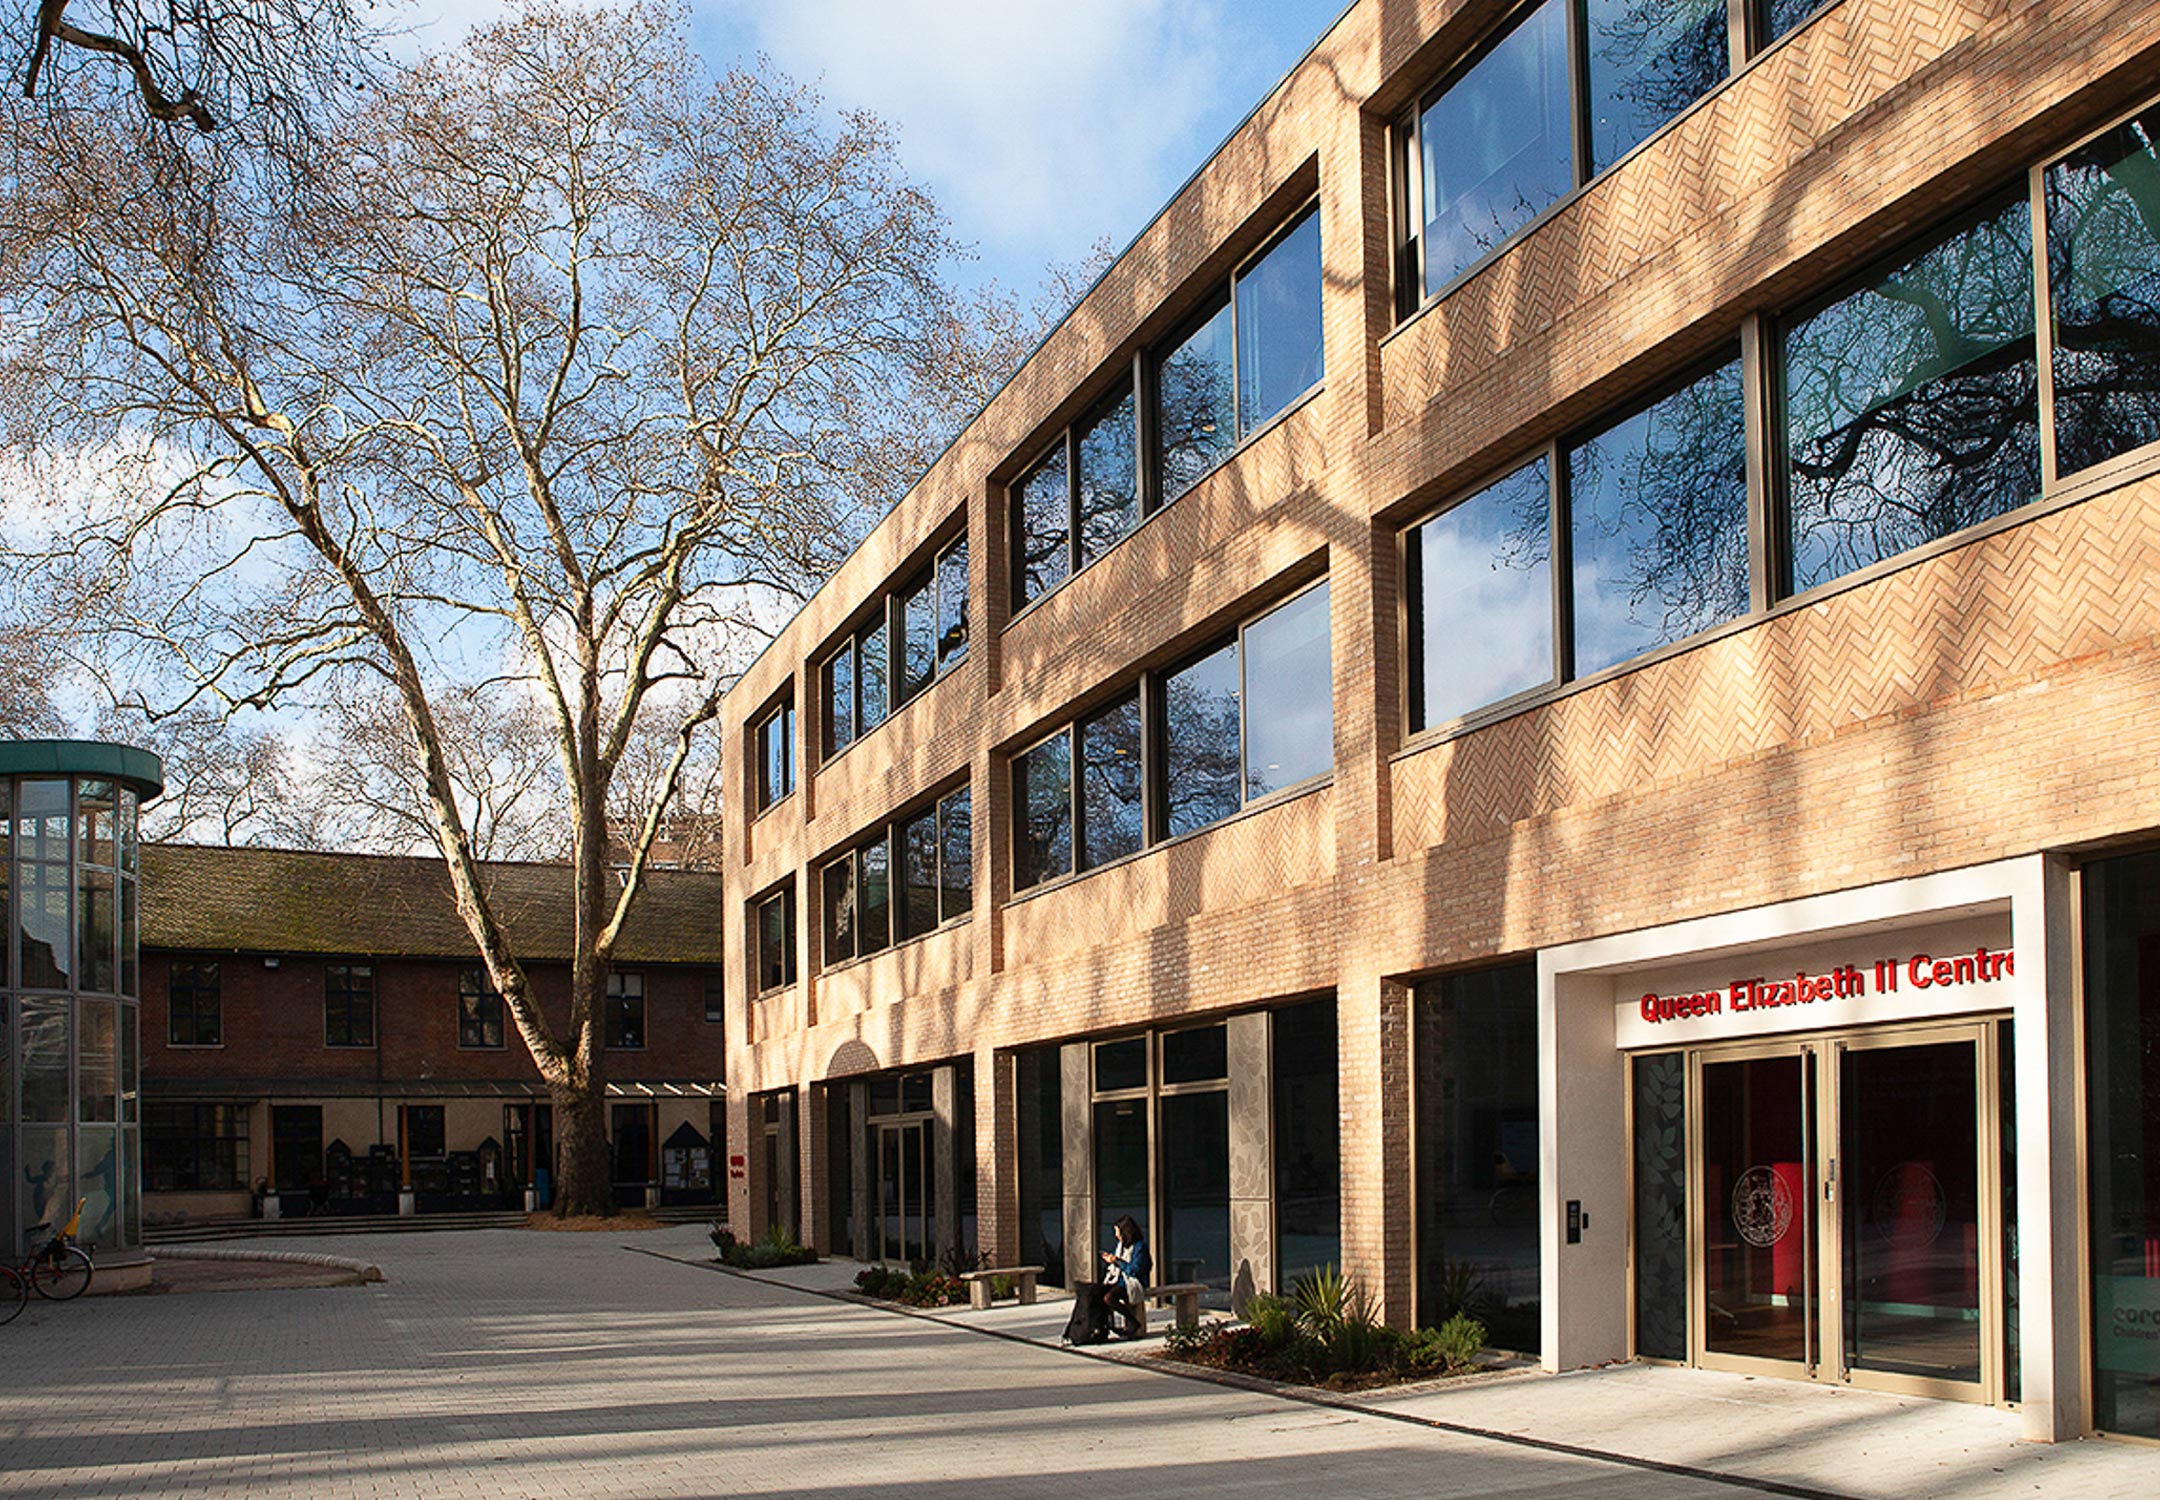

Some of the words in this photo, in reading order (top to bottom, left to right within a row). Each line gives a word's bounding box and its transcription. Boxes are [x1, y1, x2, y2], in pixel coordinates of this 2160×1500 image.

[1640, 993, 1721, 1024] Queen
[1729, 964, 1864, 1012] Elizabeth
[1875, 958, 1898, 994] II
